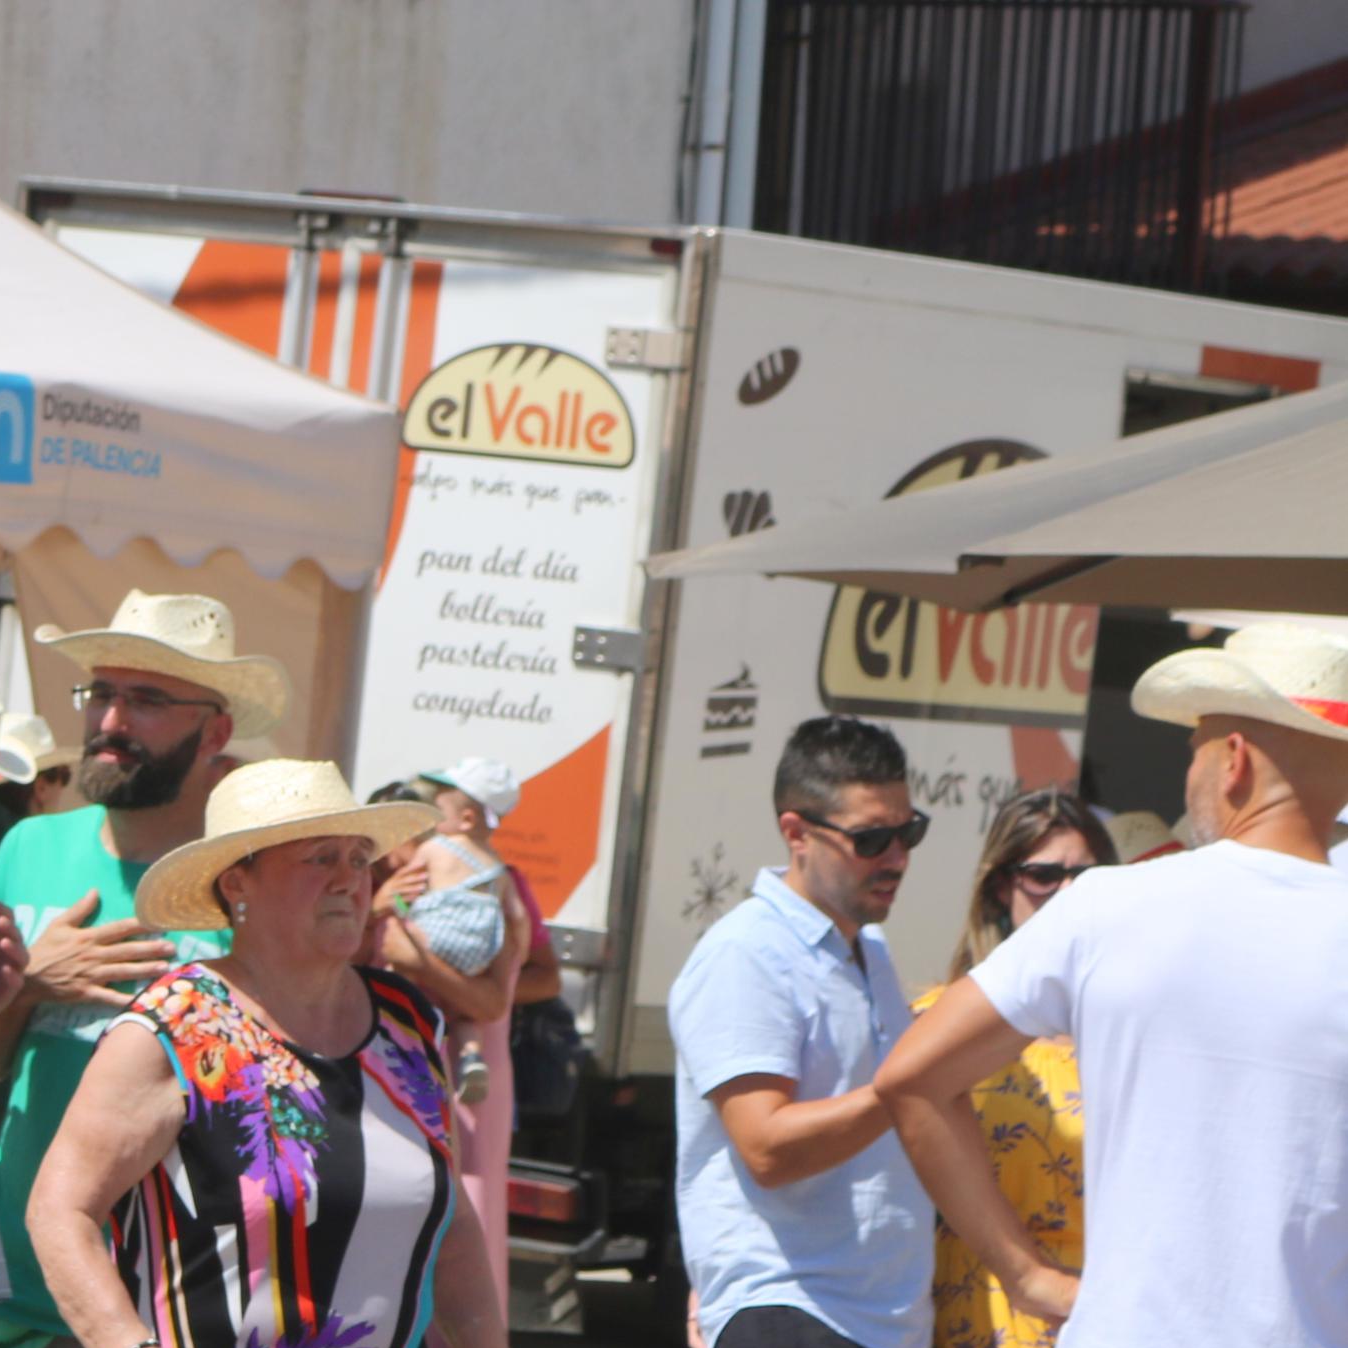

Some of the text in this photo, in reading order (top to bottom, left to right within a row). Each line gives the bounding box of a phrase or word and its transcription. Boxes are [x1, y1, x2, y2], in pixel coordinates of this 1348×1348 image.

[42, 393, 141, 434] Diputación
[427, 382, 618, 454] el Valle
[40, 436, 162, 479] DE PALENCIA
[416, 546, 579, 583] pan del día
[439, 589, 545, 629] bollería
[855, 589, 919, 680] el
[416, 639, 558, 675] pastelería
[412, 688, 553, 727] congelado
